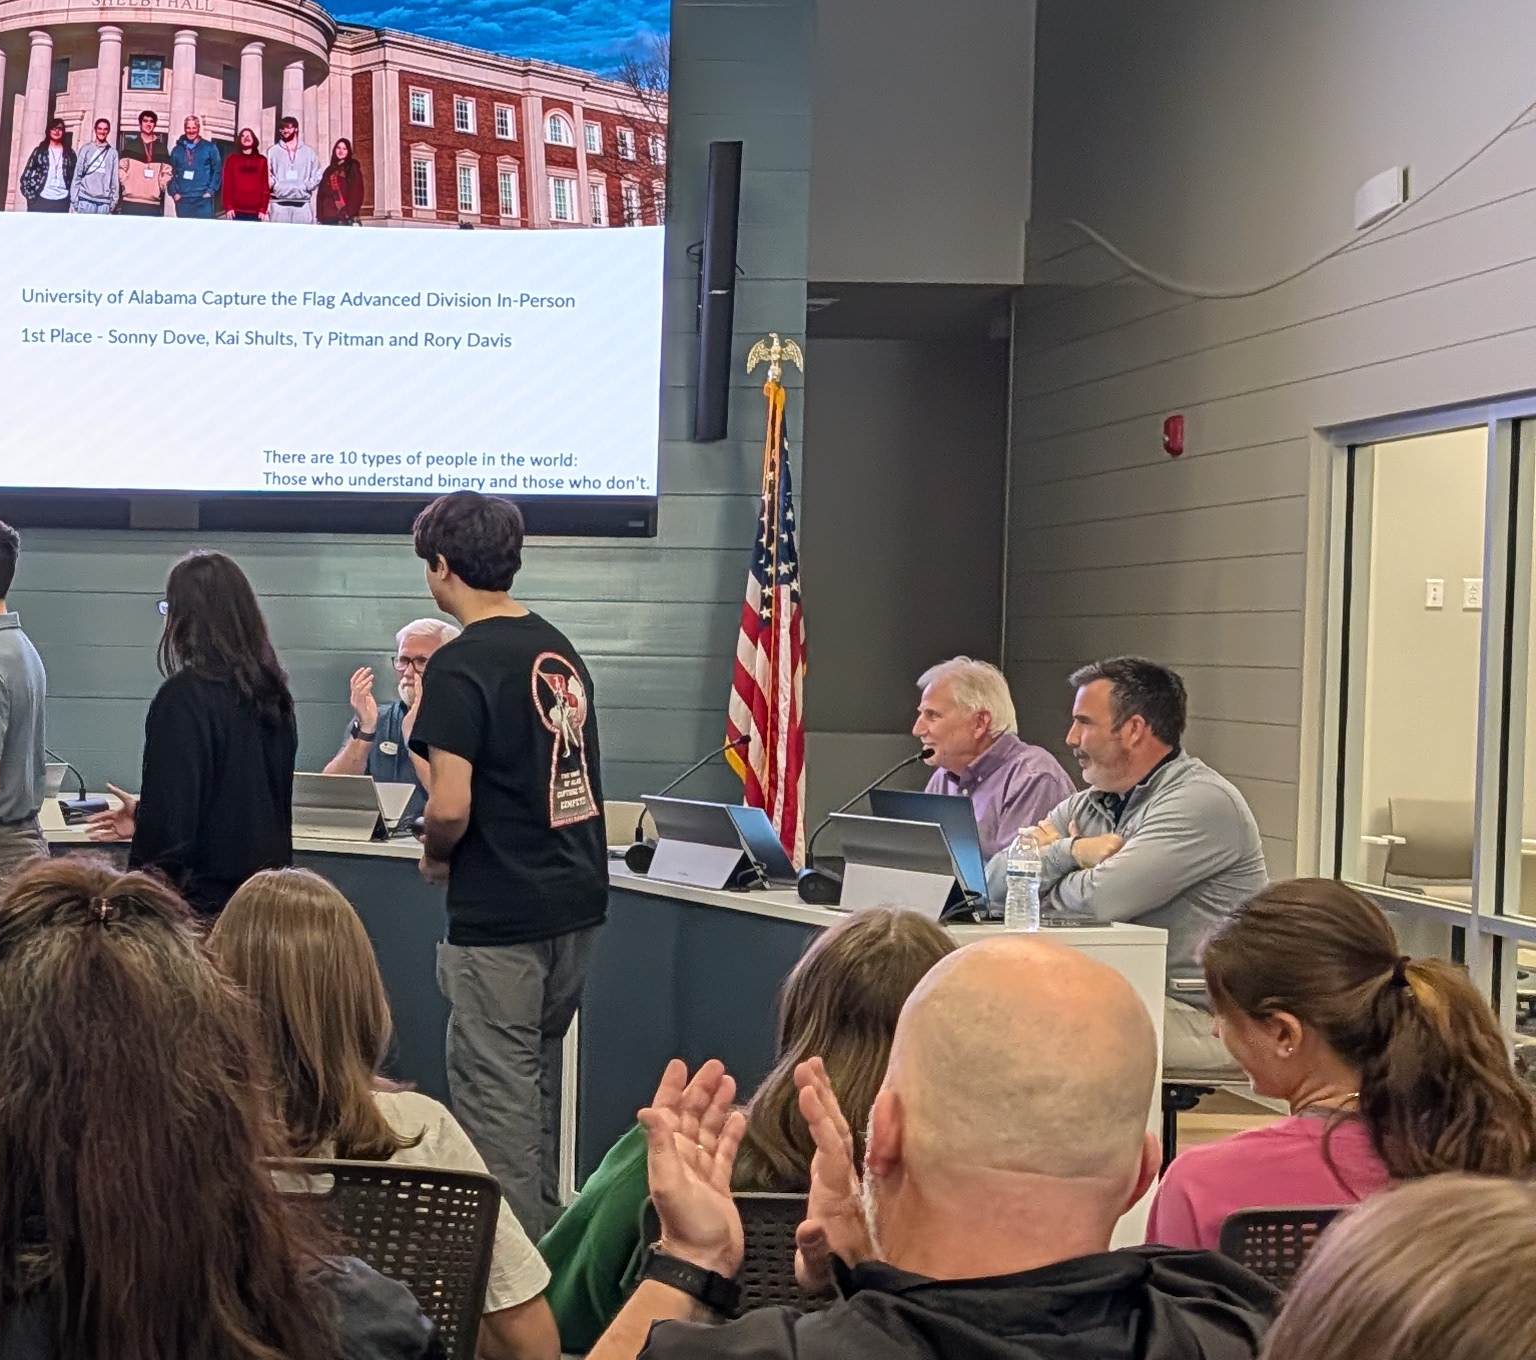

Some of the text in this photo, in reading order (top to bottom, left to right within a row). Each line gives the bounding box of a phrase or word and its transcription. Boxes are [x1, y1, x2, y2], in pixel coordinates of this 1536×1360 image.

[22, 287, 576, 310] University of Alabama Capture the Flag Advanced Division In-Person
[21, 327, 46, 343] 1st
[51, 327, 93, 344] Place
[108, 328, 158, 348] Sonny
[163, 329, 210, 347] Dove,
[215, 329, 240, 346] Kai
[244, 329, 298, 348] Shults,
[302, 330, 324, 350] Ty
[328, 331, 385, 347] Pitman
[389, 331, 419, 347] and
[423, 332, 463, 351] Rory
[467, 332, 513, 348] Davis
[263, 449, 578, 469] There are 10 types of people in the world:
[262, 471, 650, 492] Those who understand binary and those who don't.
